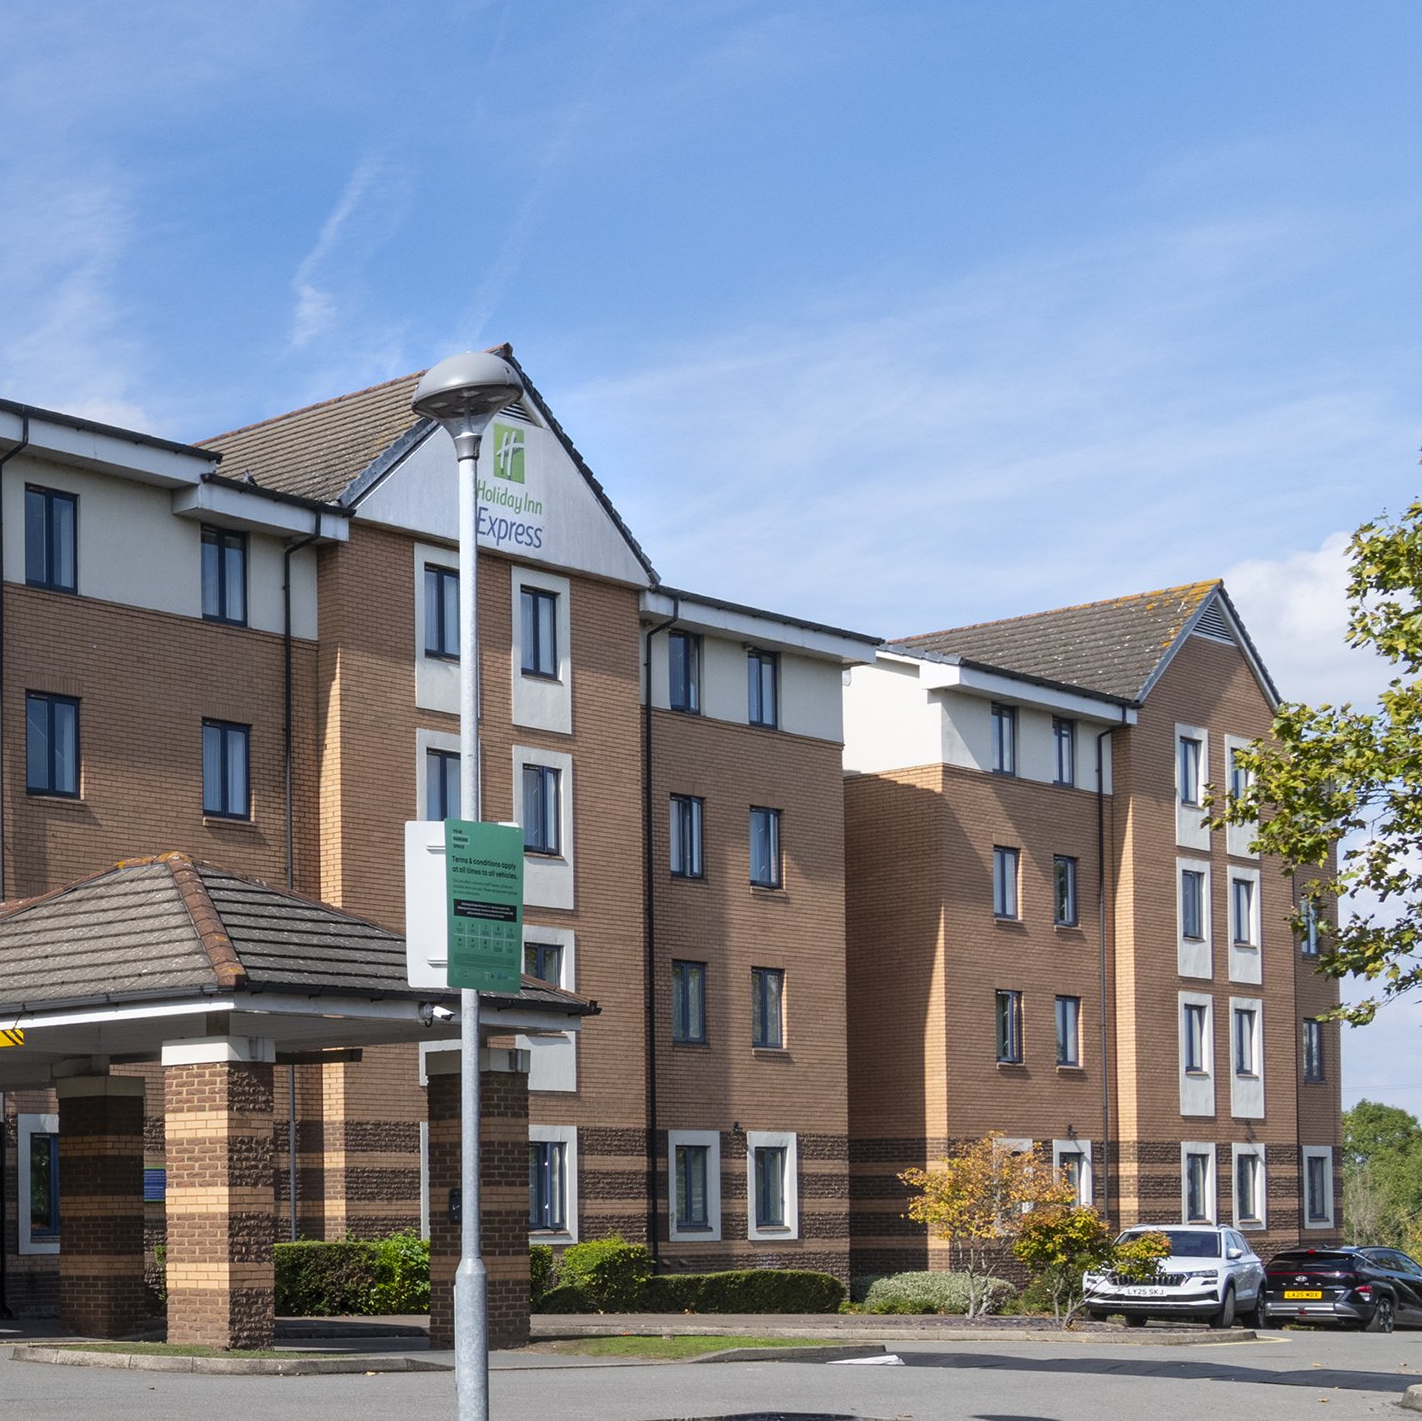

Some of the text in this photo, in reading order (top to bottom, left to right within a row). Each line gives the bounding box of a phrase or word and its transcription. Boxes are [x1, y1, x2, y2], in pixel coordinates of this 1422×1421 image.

[476, 479, 543, 515] Holiday Inn
[476, 506, 543, 549] Express
[452, 855, 468, 864] Terms
[473, 858, 501, 868] conditions
[501, 862, 517, 871] apply
[466, 867, 481, 875] times
